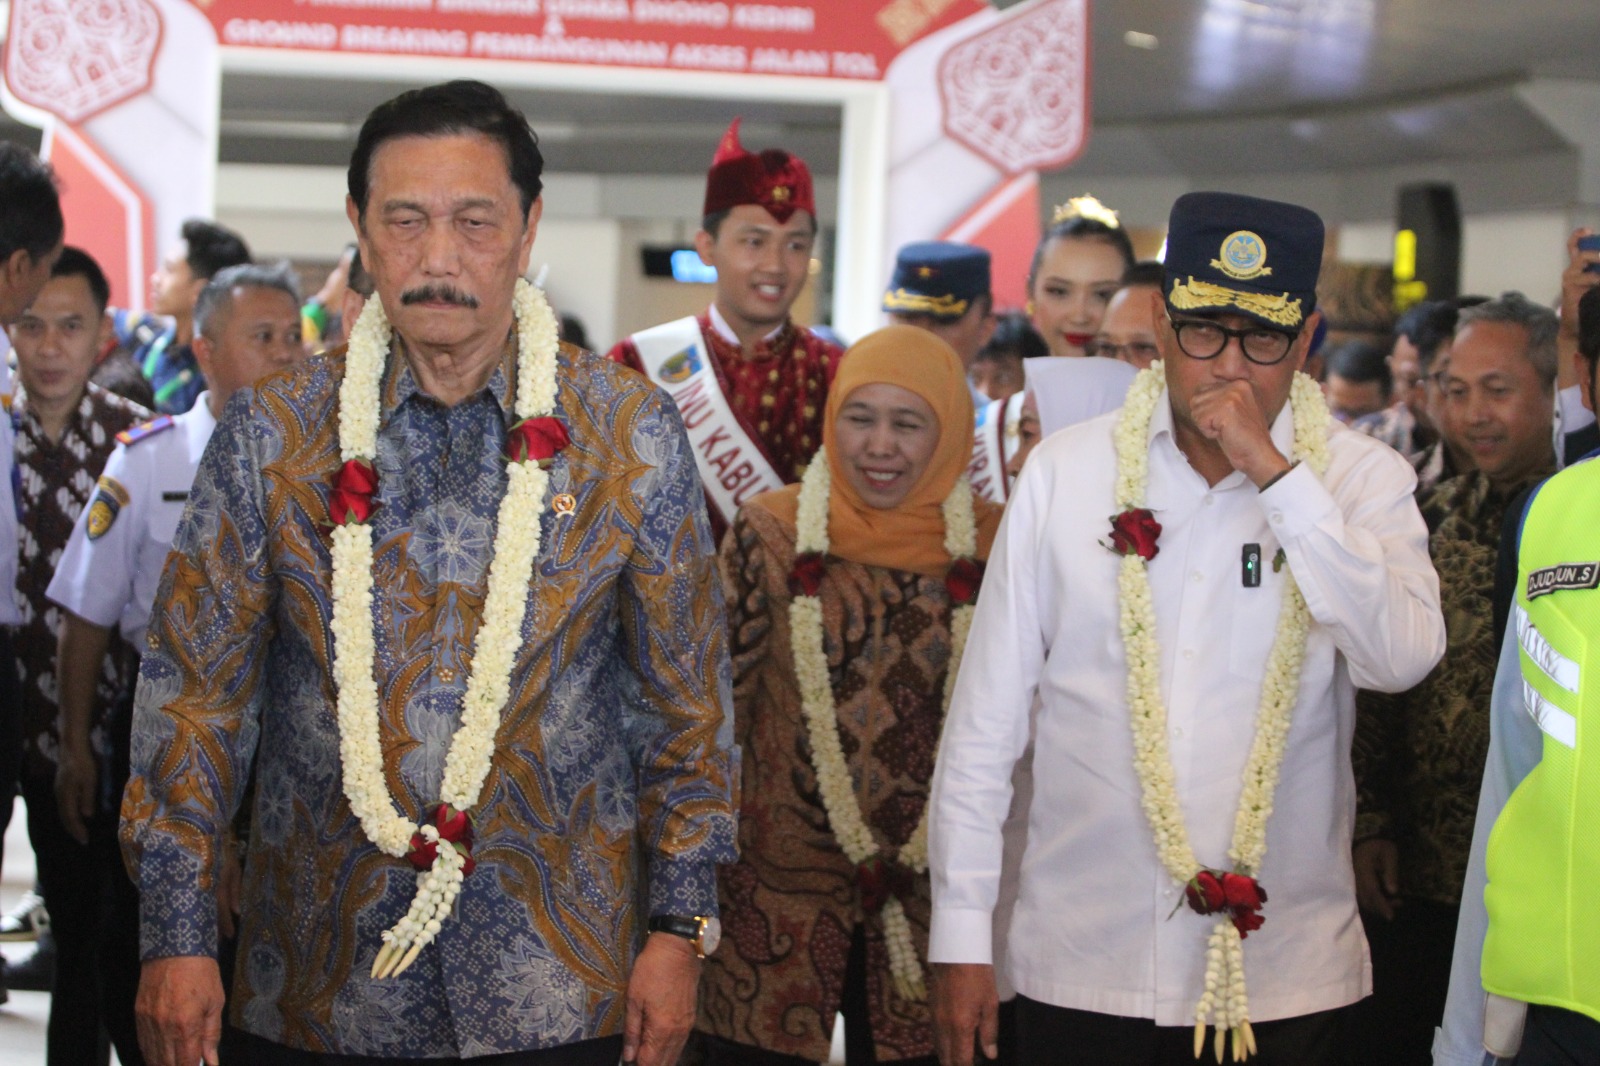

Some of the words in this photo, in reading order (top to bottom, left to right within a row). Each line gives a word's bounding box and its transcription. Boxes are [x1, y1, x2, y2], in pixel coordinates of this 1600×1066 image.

[223, 18, 338, 48] GROUND
[340, 24, 467, 55] BREAKING
[671, 43, 747, 69] AKSES
[750, 48, 828, 73] JALAN
[832, 52, 877, 77] TOL
